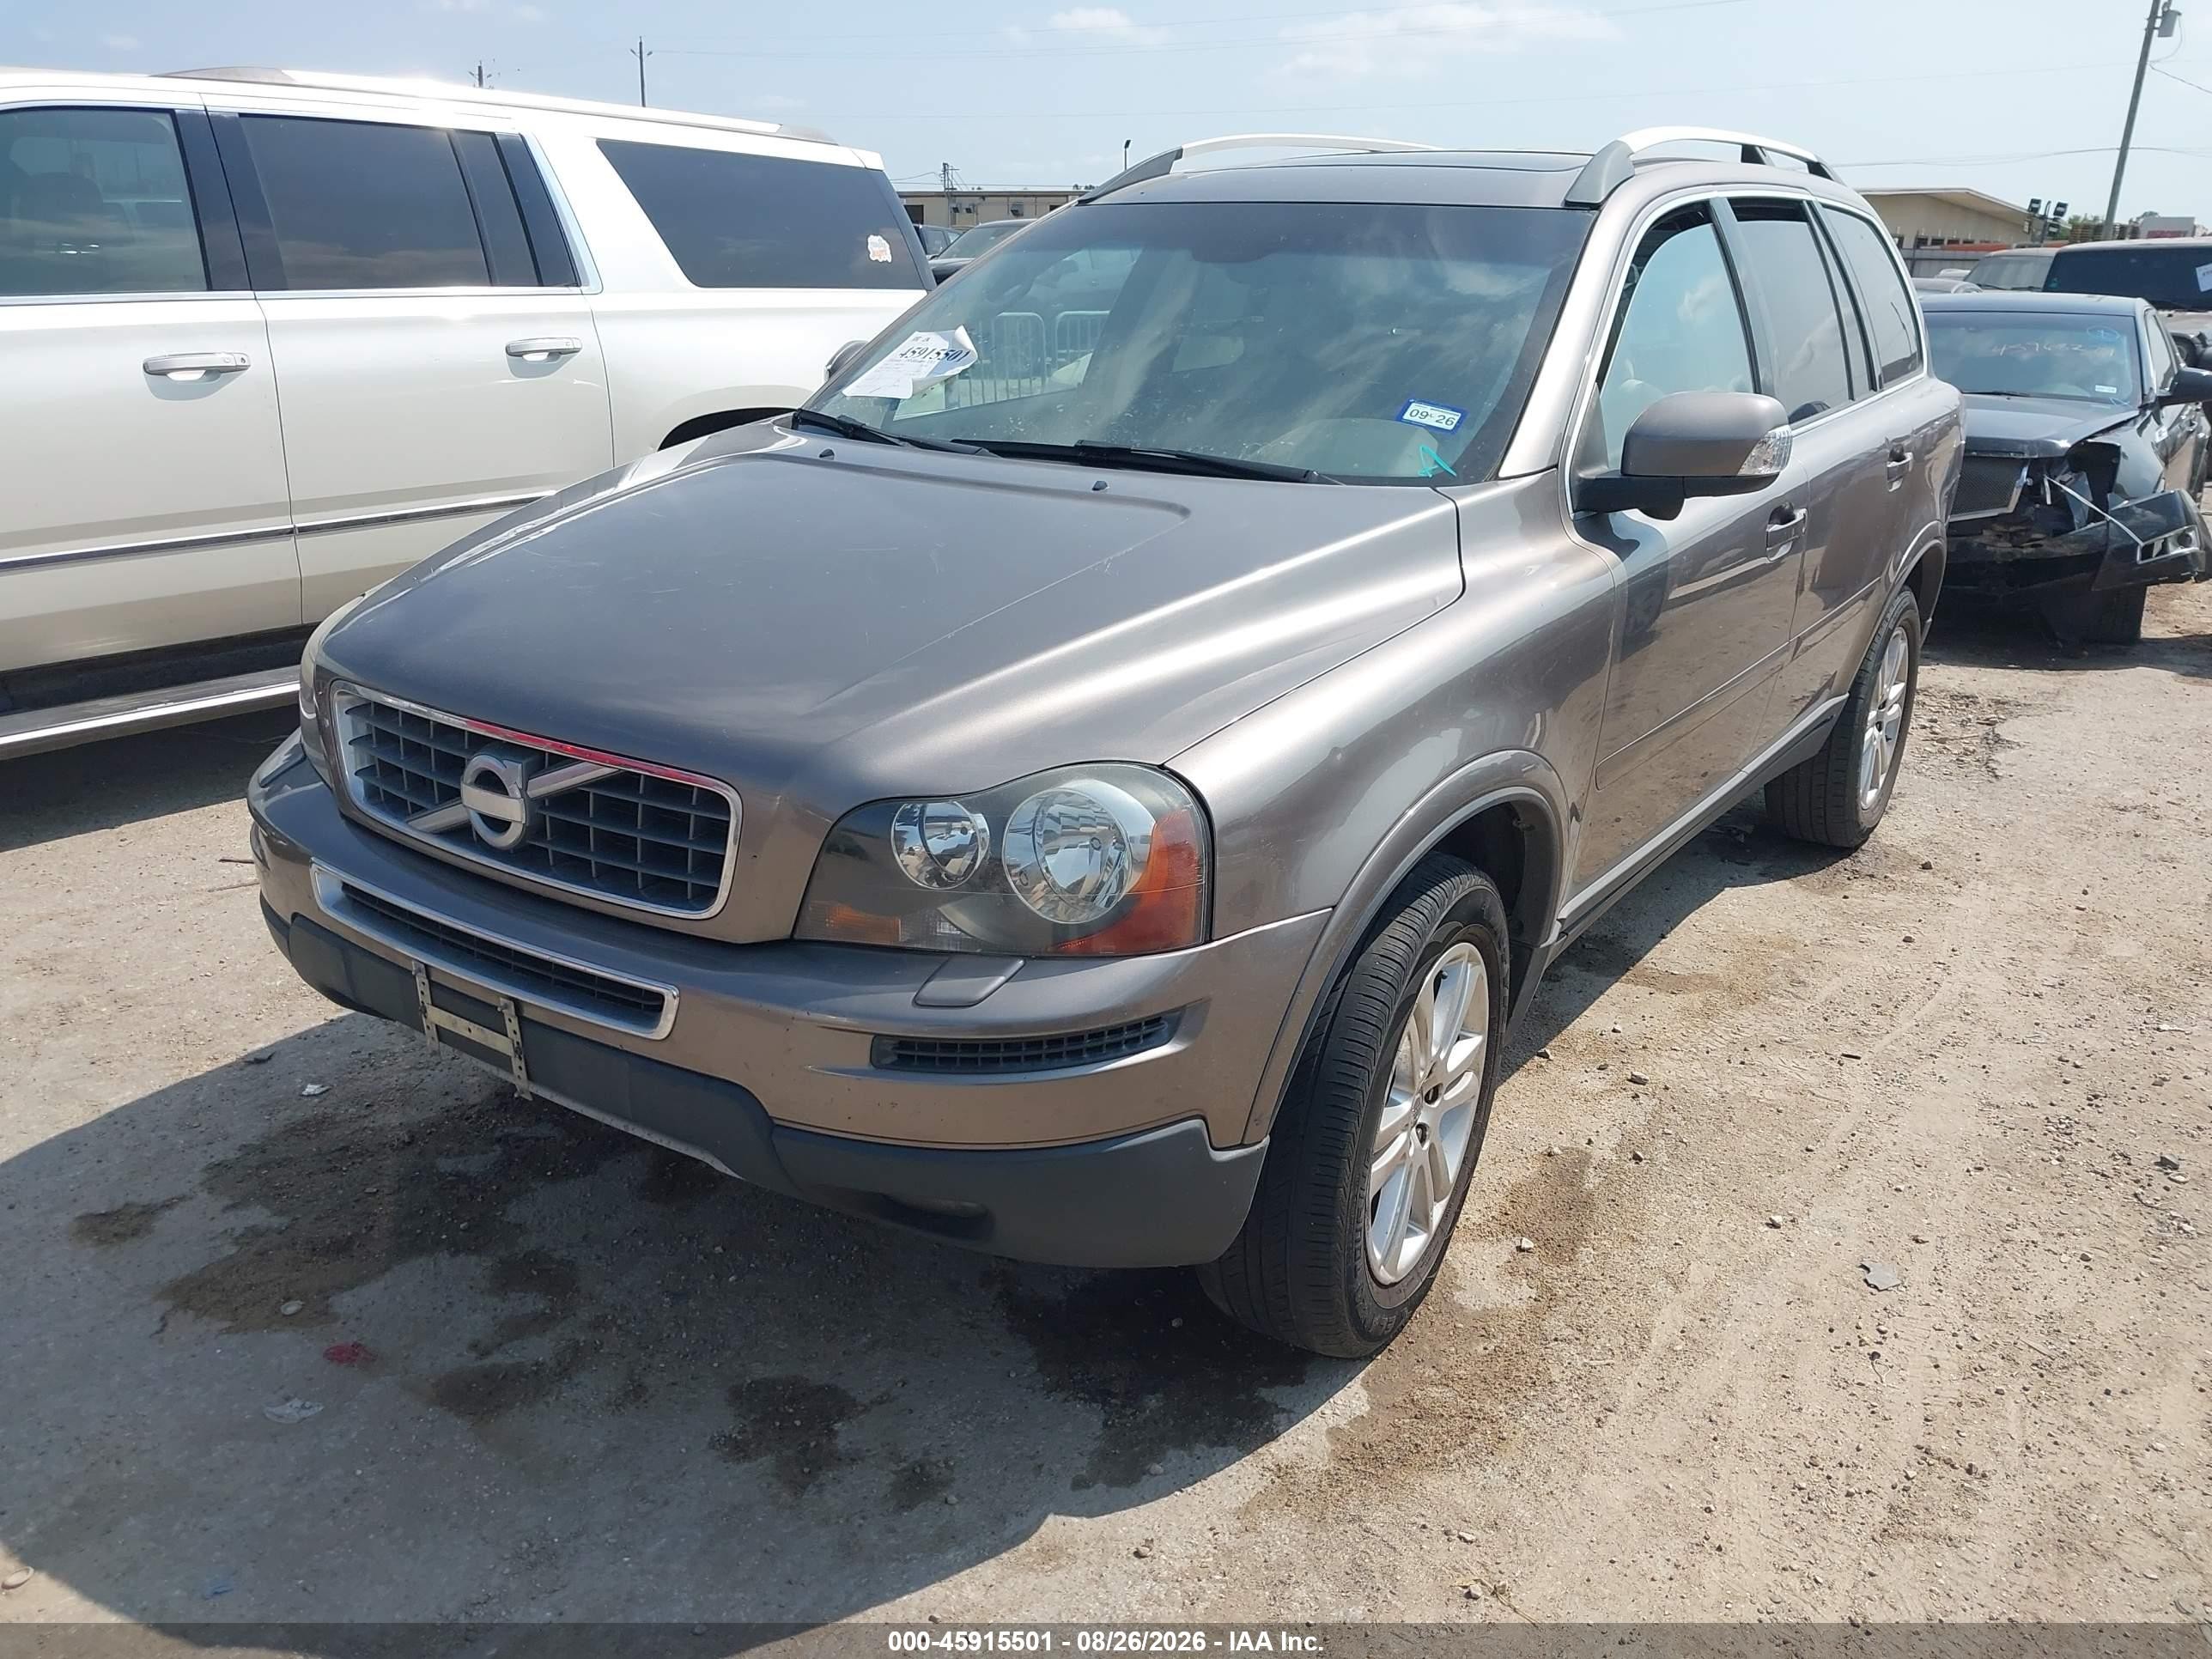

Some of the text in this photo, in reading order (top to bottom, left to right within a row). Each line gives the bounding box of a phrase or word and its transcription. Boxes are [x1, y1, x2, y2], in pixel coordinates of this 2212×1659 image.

[899, 346, 971, 362] 45915501
[1409, 409, 1456, 427] 09 26
